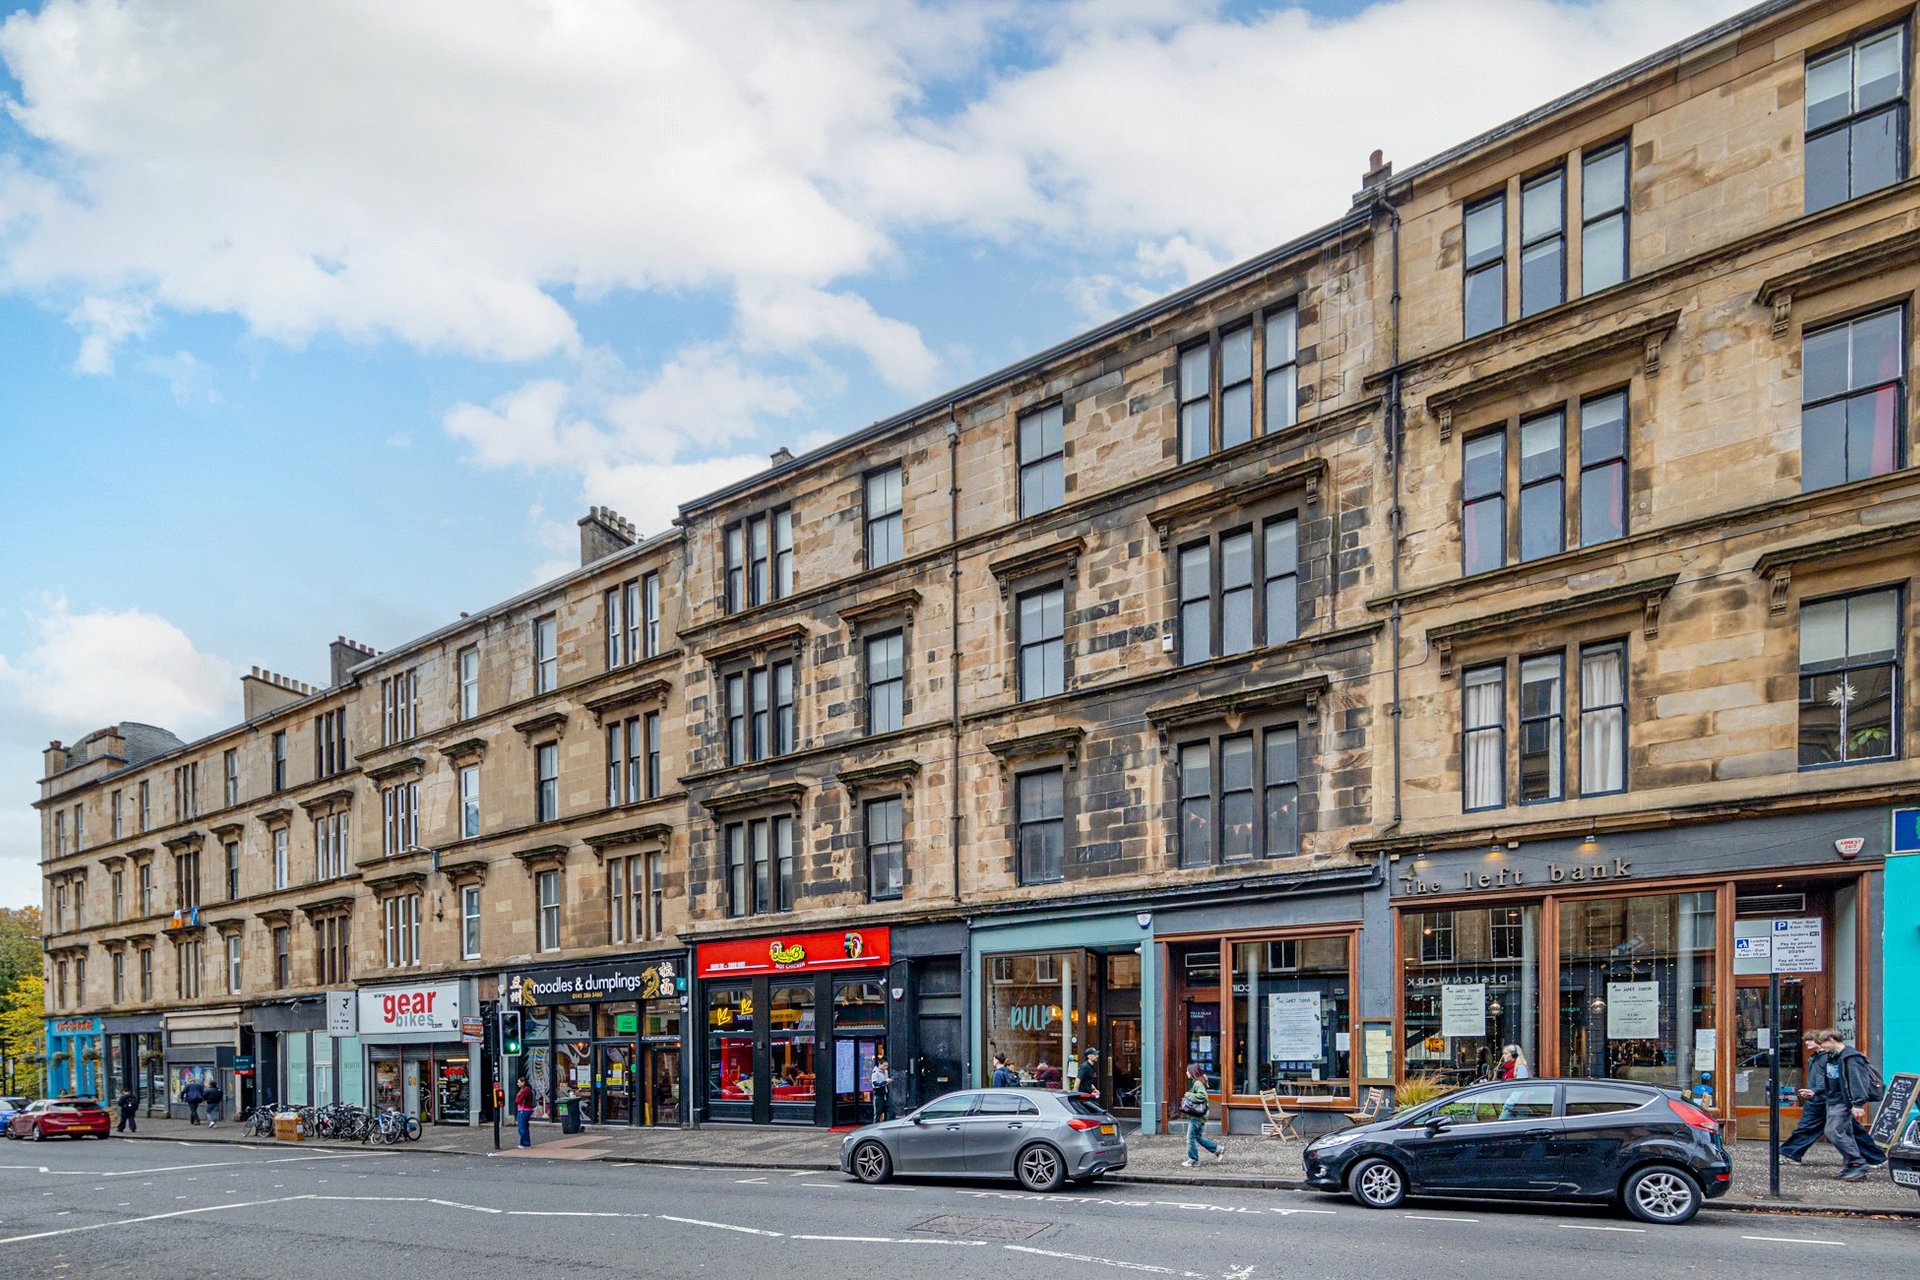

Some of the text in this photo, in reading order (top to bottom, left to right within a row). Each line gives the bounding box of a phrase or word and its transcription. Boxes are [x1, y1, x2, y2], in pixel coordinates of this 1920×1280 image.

[1406, 857, 1632, 894] the left bank
[533, 972, 641, 995] noodles & dumplings
[383, 991, 437, 1023] gear
[396, 1012, 434, 1027] bikes
[1010, 1004, 1053, 1031] PULP
